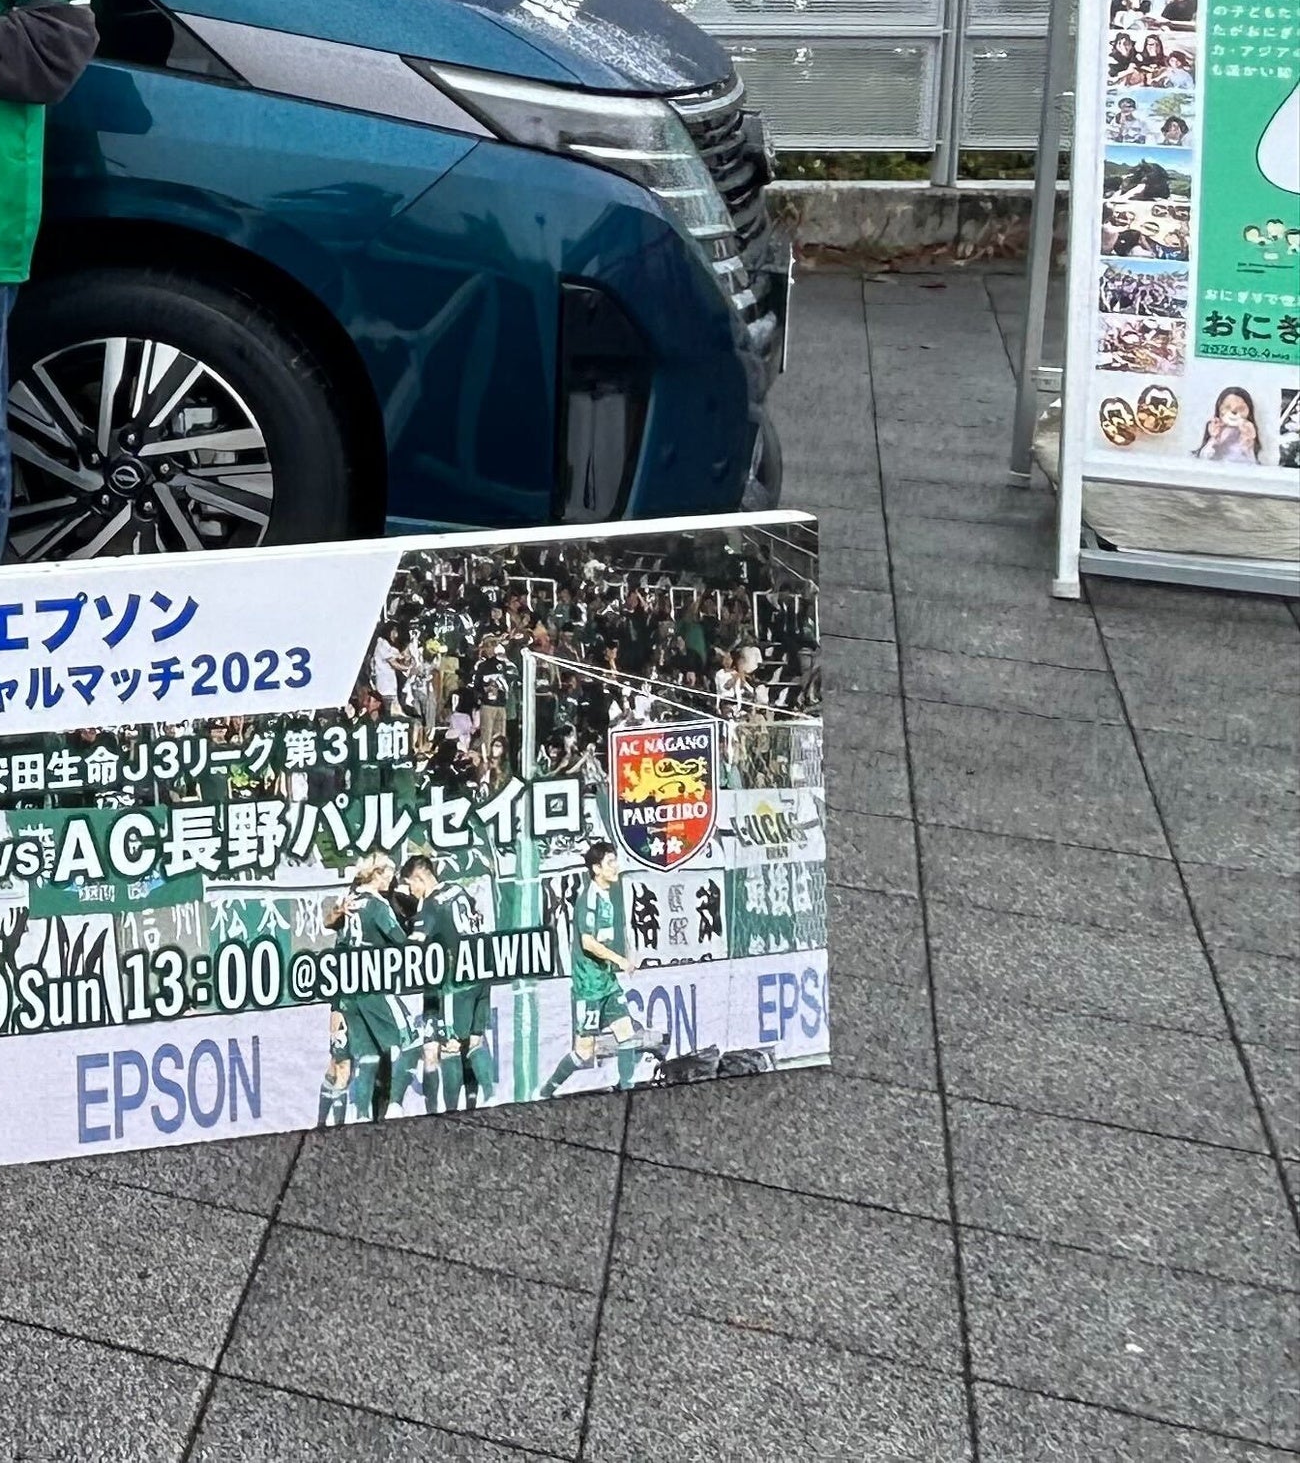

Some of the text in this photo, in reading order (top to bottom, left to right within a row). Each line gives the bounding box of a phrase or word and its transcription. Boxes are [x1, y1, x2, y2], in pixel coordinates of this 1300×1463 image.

[619, 734, 709, 757] AC NAGANO
[54, 776, 582, 883] AC長野パルセイロ
[125, 939, 281, 1020] 13:00
[291, 942, 446, 998] @SUNPRO
[455, 930, 551, 982] ALWIN
[758, 967, 828, 1043] EPS
[77, 1036, 263, 1144] EPSON
